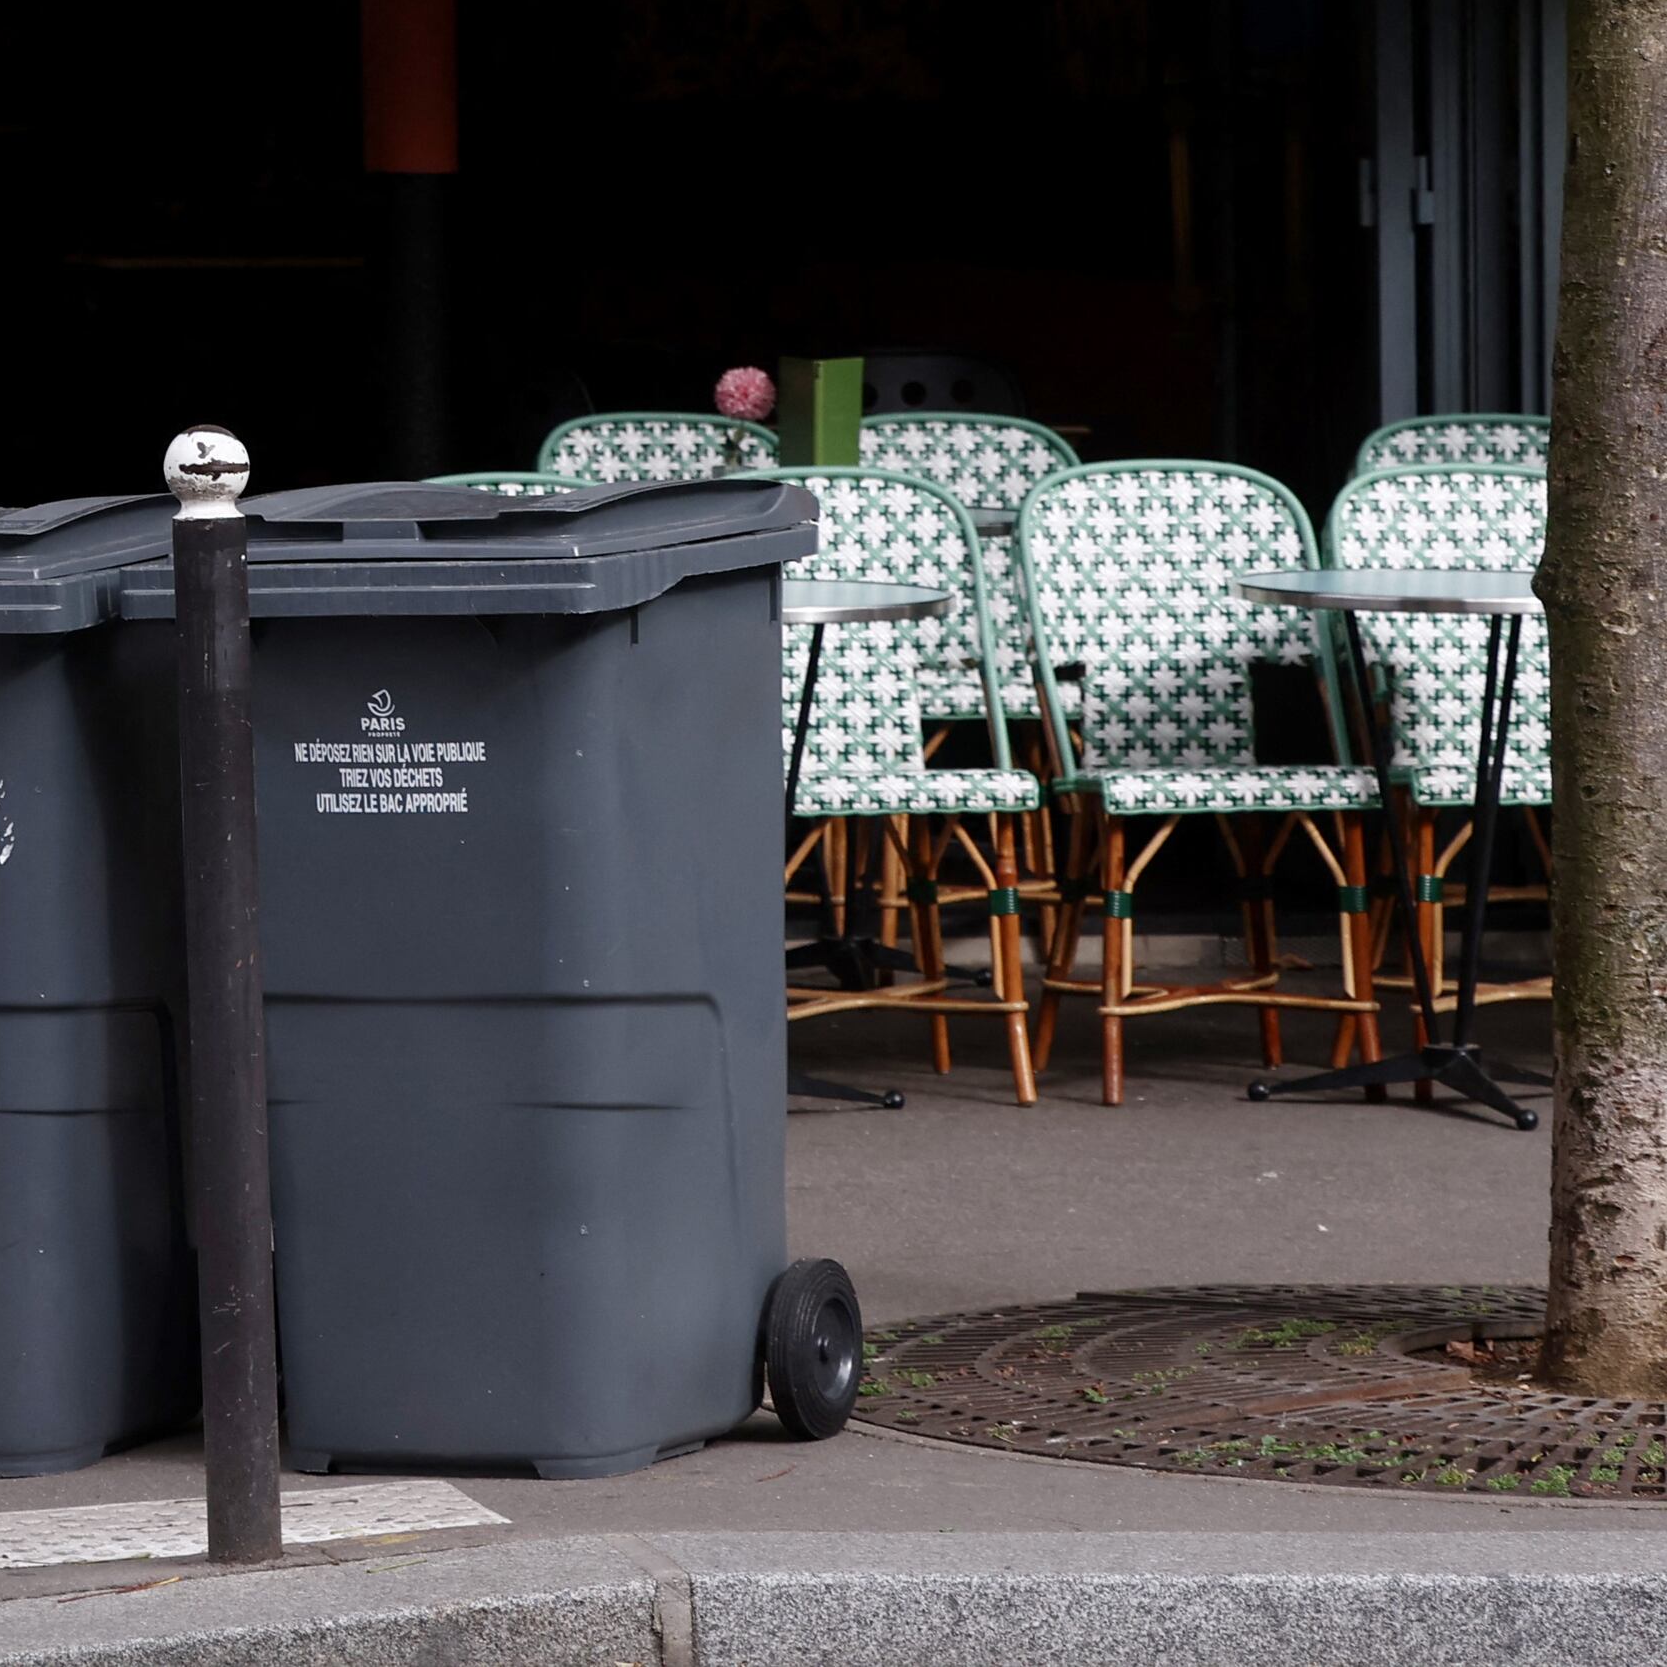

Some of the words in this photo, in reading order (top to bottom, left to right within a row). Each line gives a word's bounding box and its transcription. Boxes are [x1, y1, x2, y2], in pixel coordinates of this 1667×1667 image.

[361, 717, 405, 731] PARIS
[295, 743, 308, 762] NE
[310, 739, 351, 763] DÉPOSEZ
[353, 744, 374, 763] RIEN
[376, 744, 395, 763] SUR
[397, 744, 410, 763] LA
[412, 743, 435, 762] VOIE
[437, 742, 486, 762] PUBLIQUE
[340, 768, 369, 788] TRIEZ
[370, 768, 391, 787] VOS
[394, 764, 442, 787] DÉCHETS
[317, 793, 362, 813] UTILISEZ
[364, 794, 378, 812] LE
[380, 793, 403, 813] BAC
[405, 788, 467, 812] APPROPRIÉ
